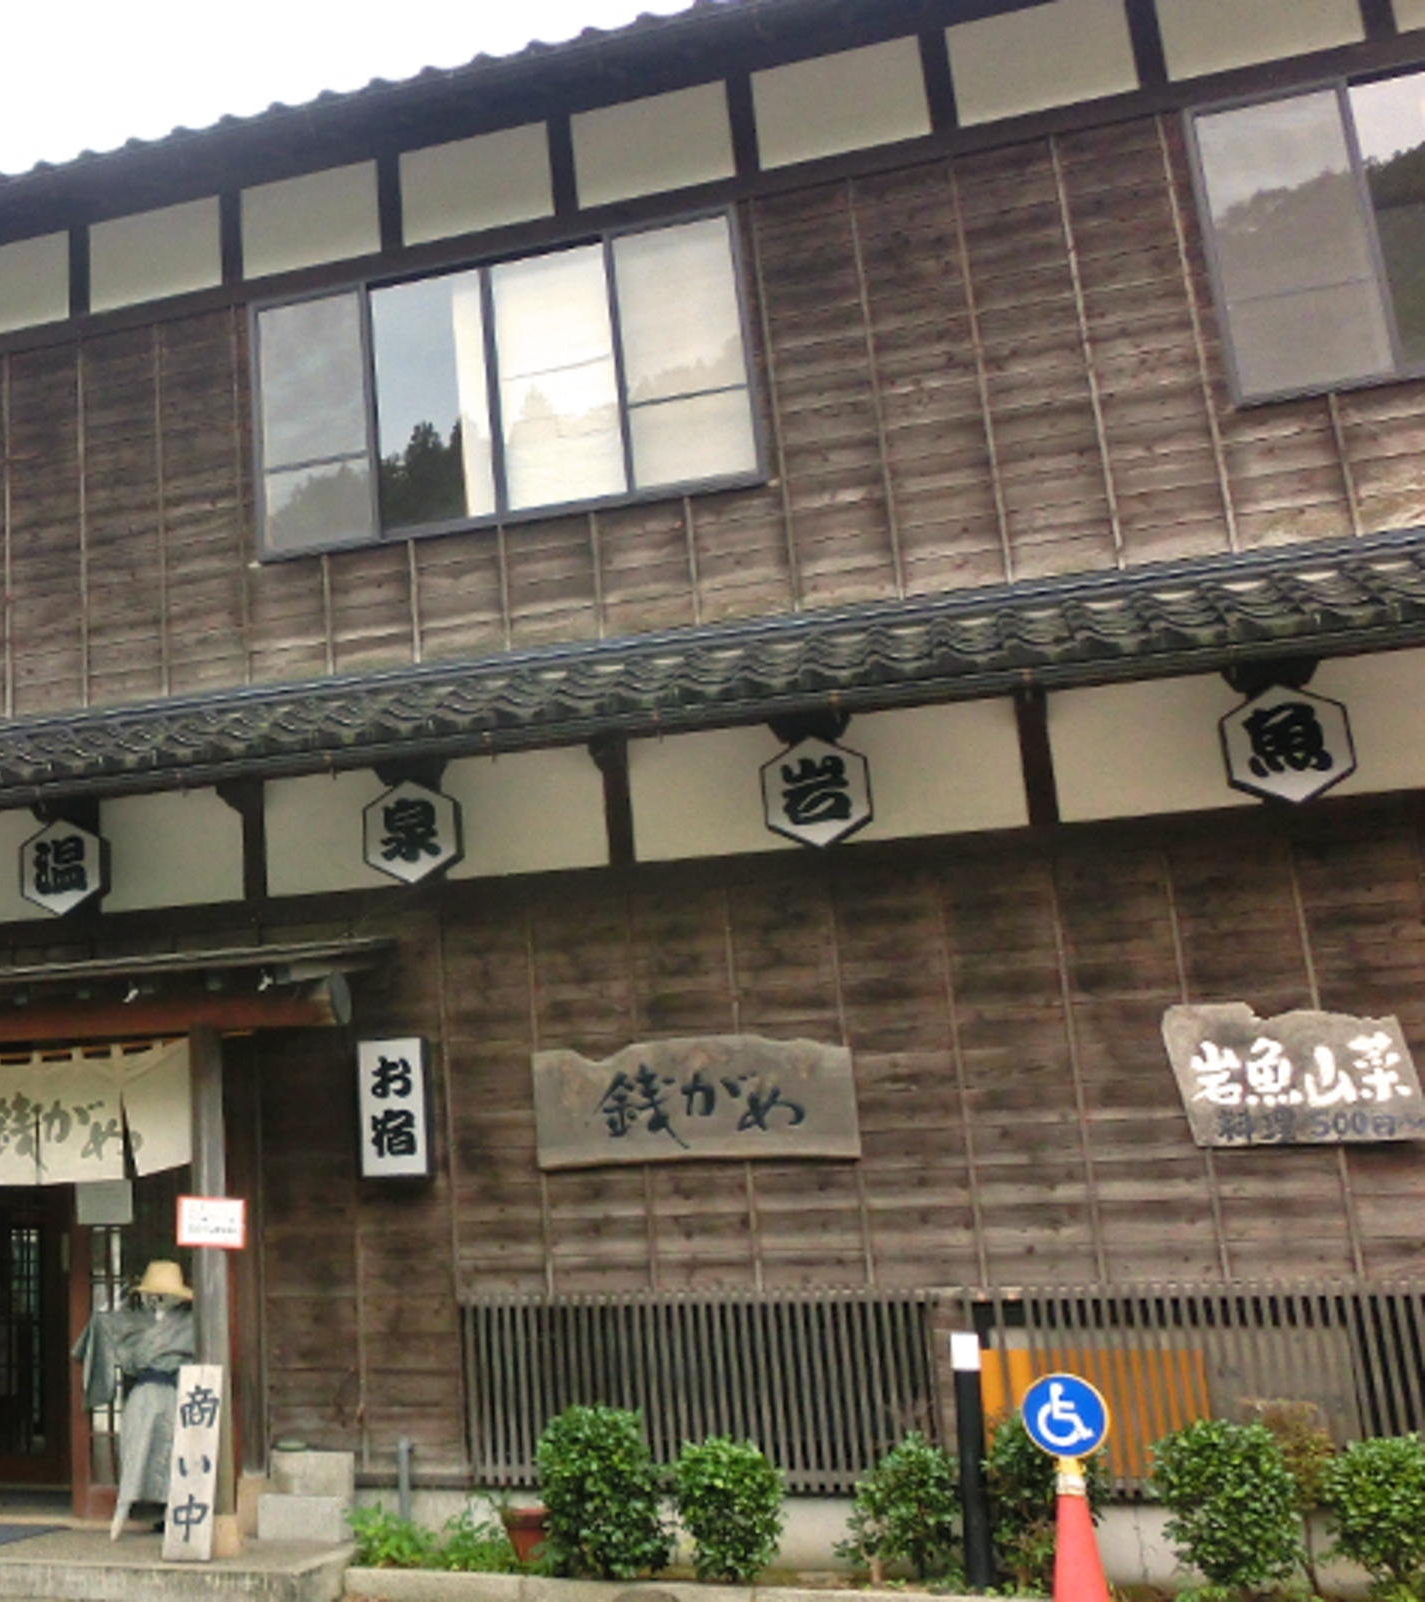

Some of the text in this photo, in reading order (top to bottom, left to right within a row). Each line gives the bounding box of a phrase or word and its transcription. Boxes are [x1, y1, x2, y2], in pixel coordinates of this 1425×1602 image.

[33, 836, 88, 895] 温
[380, 798, 442, 863] 泉
[781, 755, 853, 826] 岩
[1242, 702, 1334, 777] 魚
[371, 1055, 418, 1159] お宿
[1190, 1031, 1413, 1108] 岩魚山菜
[172, 1384, 220, 1543] 商い中
